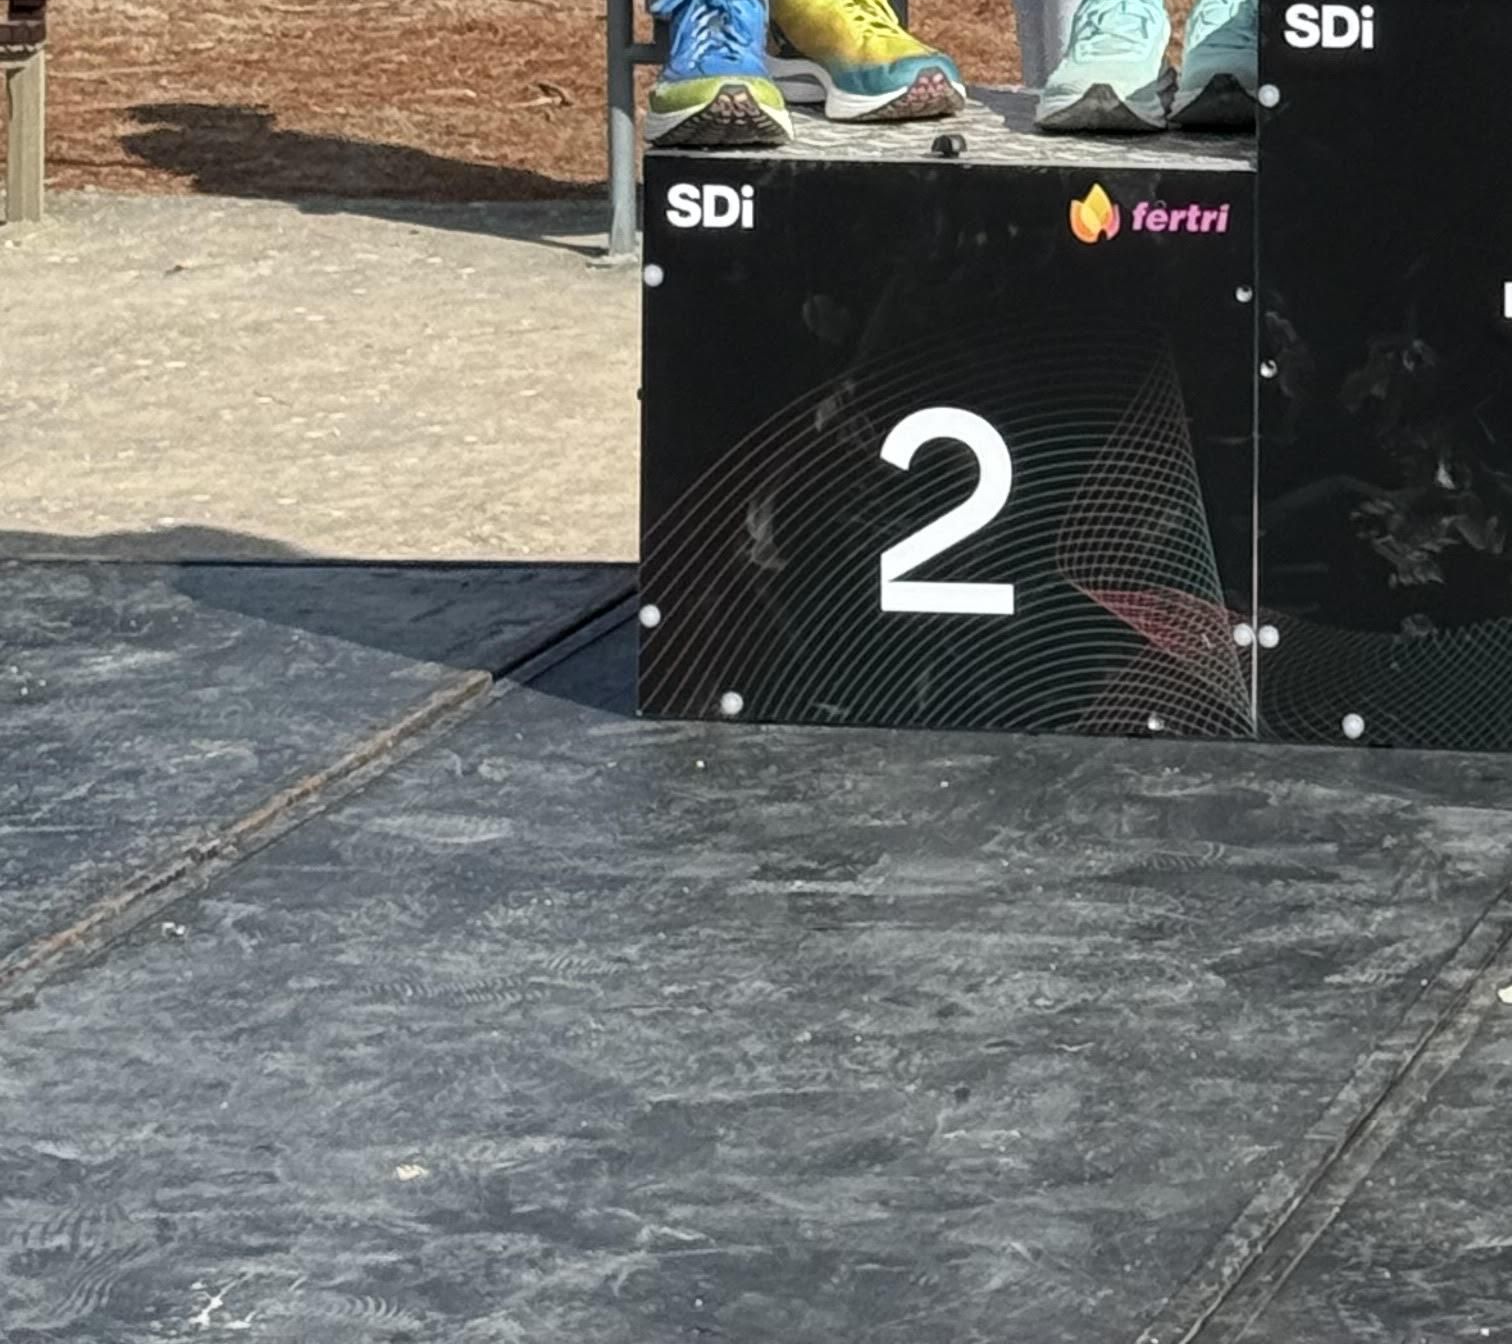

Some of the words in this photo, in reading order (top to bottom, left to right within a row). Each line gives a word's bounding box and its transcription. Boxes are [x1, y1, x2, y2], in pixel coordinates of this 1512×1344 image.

[1284, 3, 1375, 50] SDi
[666, 182, 755, 229] SDi
[1132, 202, 1231, 234] fertri
[879, 406, 1015, 615] 2
